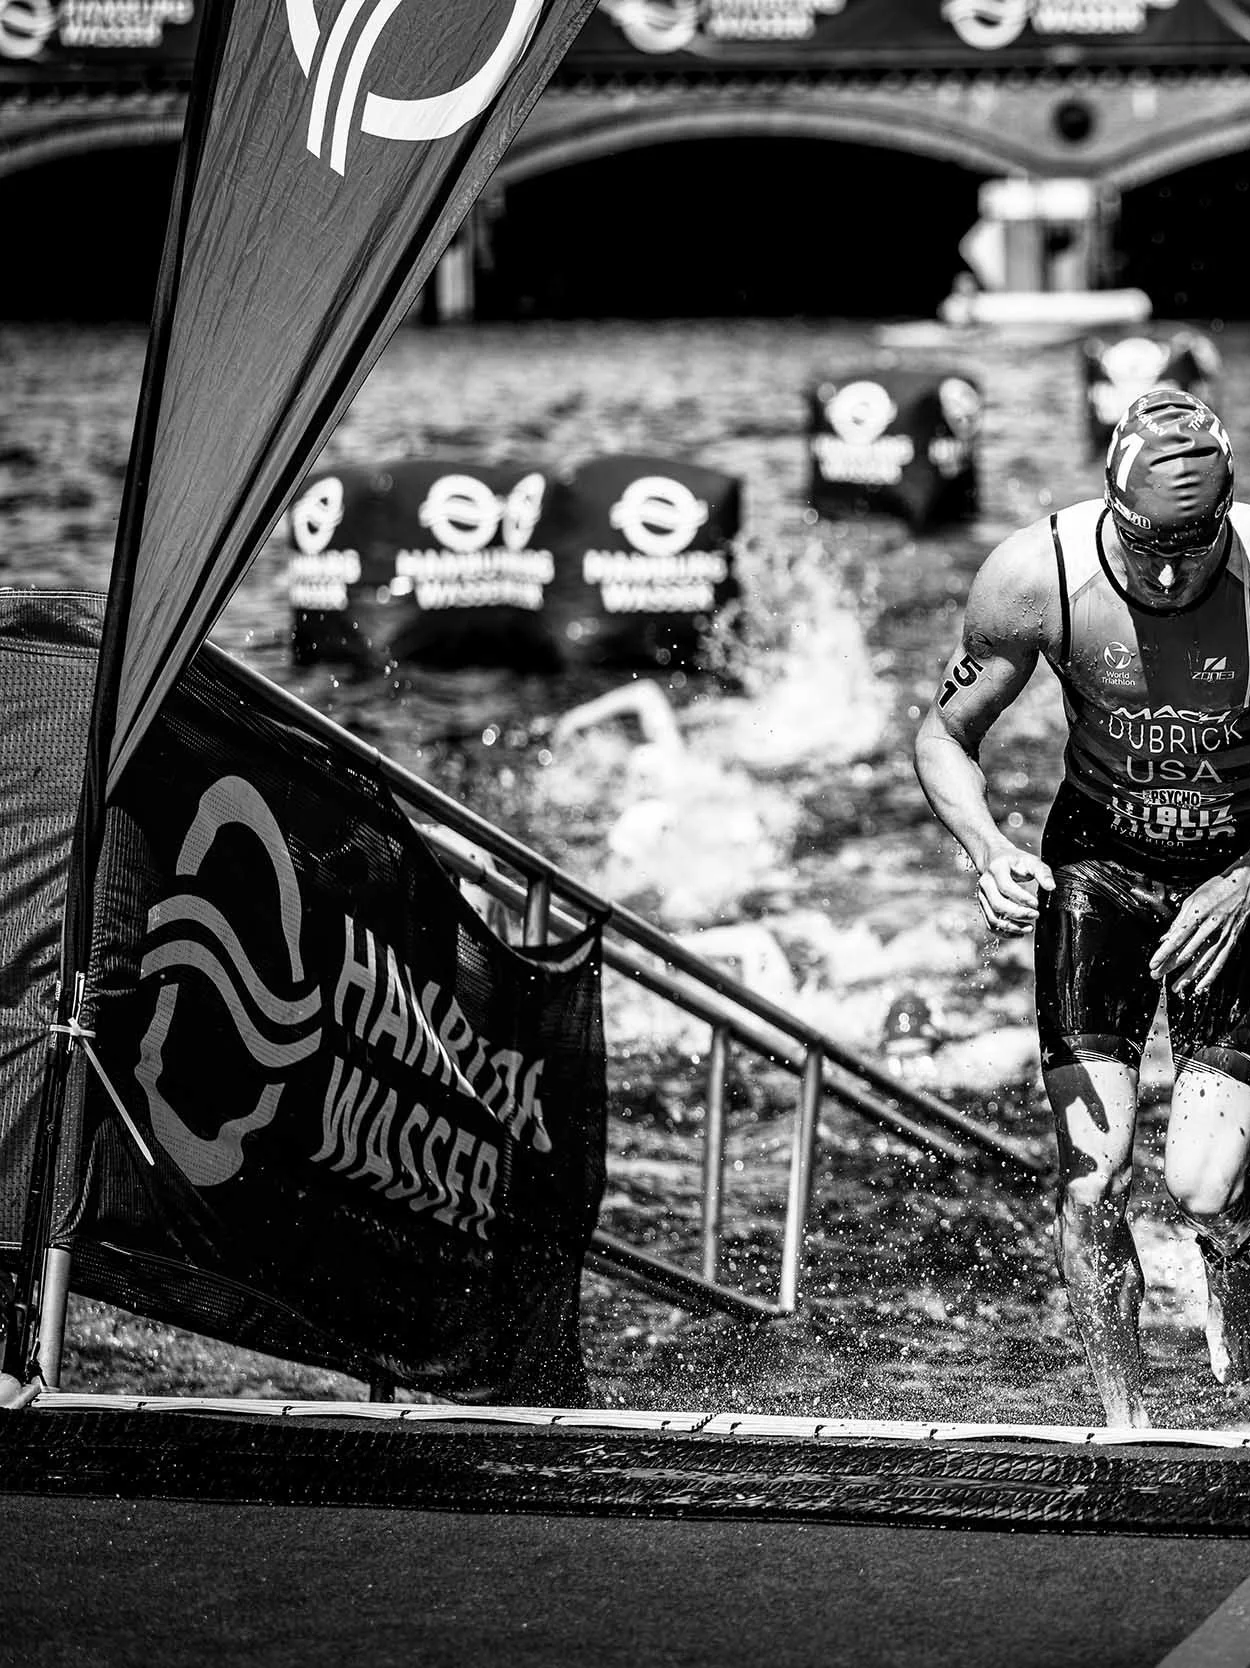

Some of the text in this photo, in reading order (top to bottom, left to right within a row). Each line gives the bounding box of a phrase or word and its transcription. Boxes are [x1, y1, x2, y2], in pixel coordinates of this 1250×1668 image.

[1101, 677, 1136, 687] Triathlon
[1106, 671, 1131, 679] World
[1108, 714, 1243, 755] DUBRICK
[1126, 755, 1223, 784] USA
[1151, 790, 1200, 806] PSYCHO
[309, 1055, 499, 1241] WASSER
